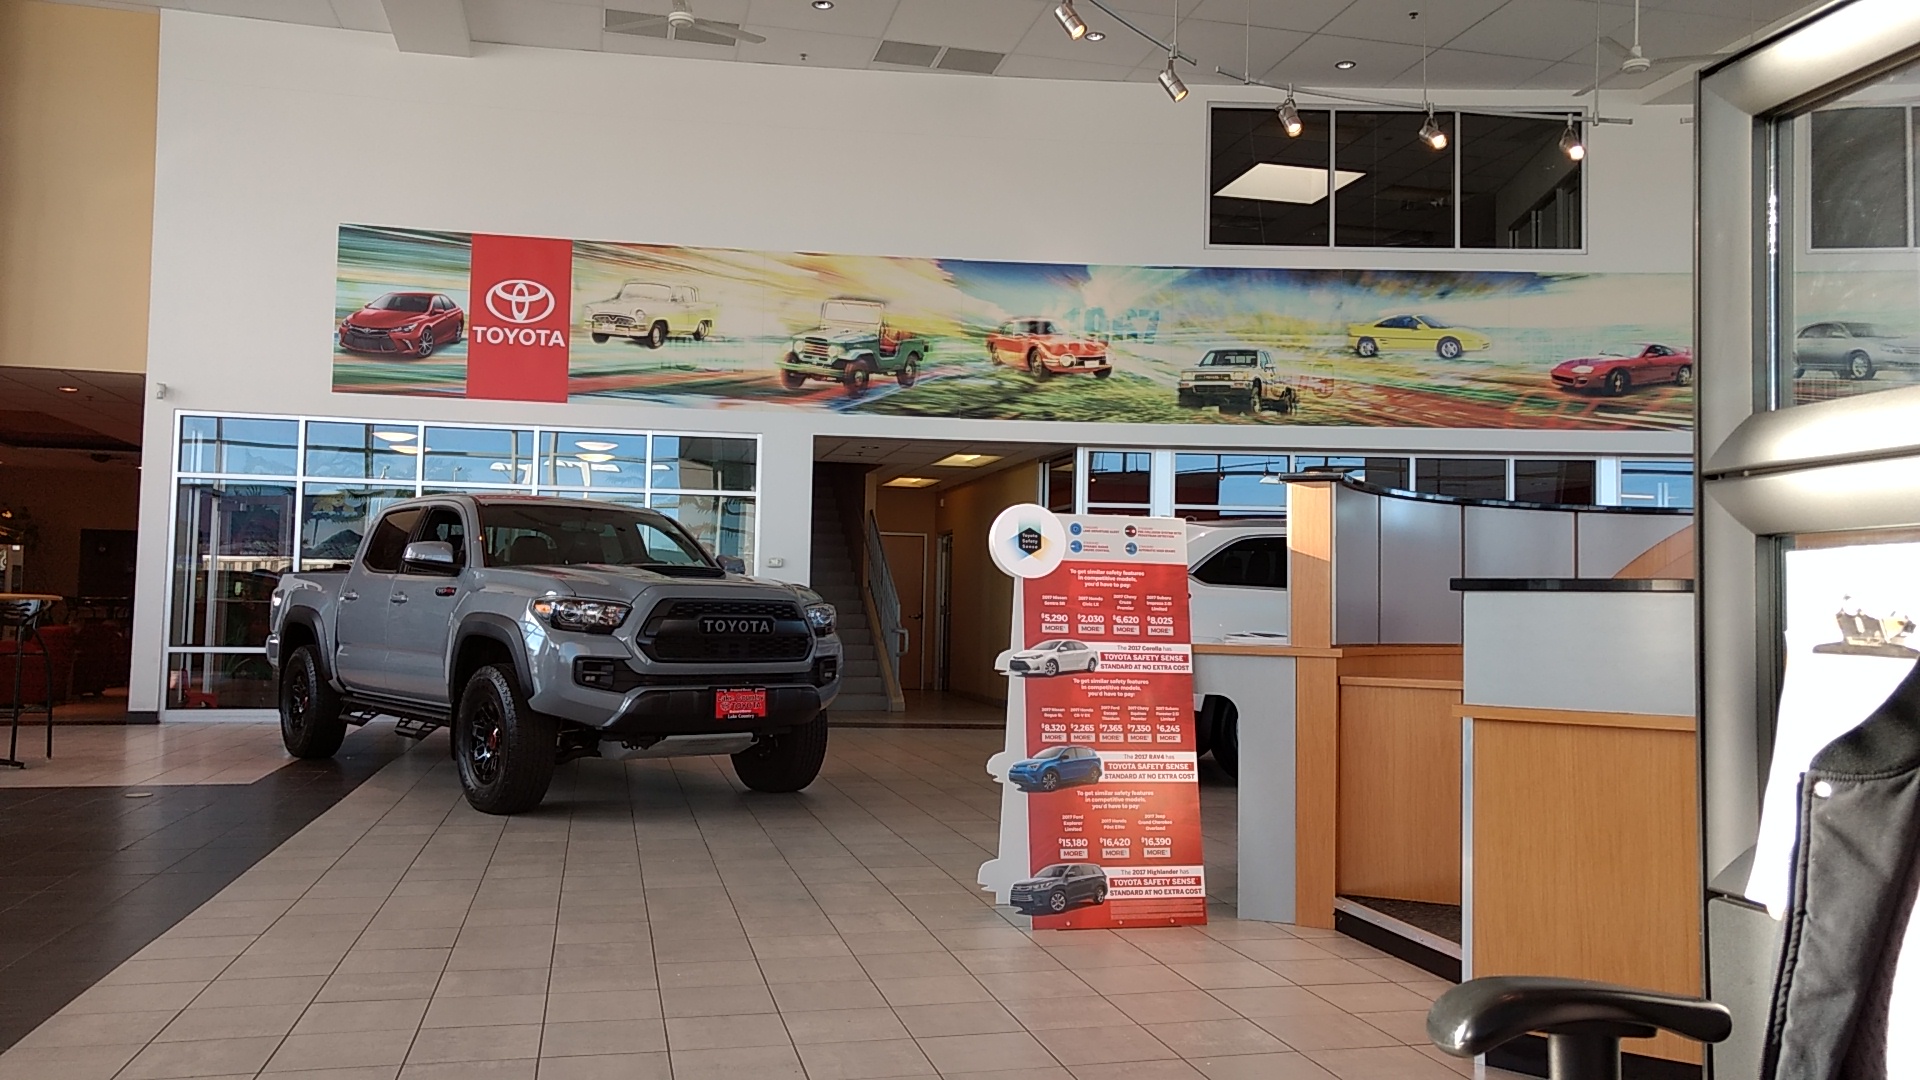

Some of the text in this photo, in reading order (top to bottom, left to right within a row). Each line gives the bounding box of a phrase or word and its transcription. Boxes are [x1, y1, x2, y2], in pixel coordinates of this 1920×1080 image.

[473, 325, 565, 348] TOYOTA
[1041, 612, 1068, 622] $5,290
[1077, 614, 1104, 623] $2,030
[1113, 614, 1139, 624] $6,620
[1147, 615, 1173, 625] $8,025
[704, 620, 770, 632] TOYOTA
[1041, 723, 1066, 732] $8,320
[1070, 723, 1094, 732] $2,265
[1100, 724, 1123, 732] $7,365
[1127, 724, 1151, 732] $7,350
[1157, 724, 1180, 732] $6,245
[1058, 838, 1088, 847] $15,180
[1100, 837, 1130, 846] $16,420
[1141, 837, 1171, 846] $16,390
